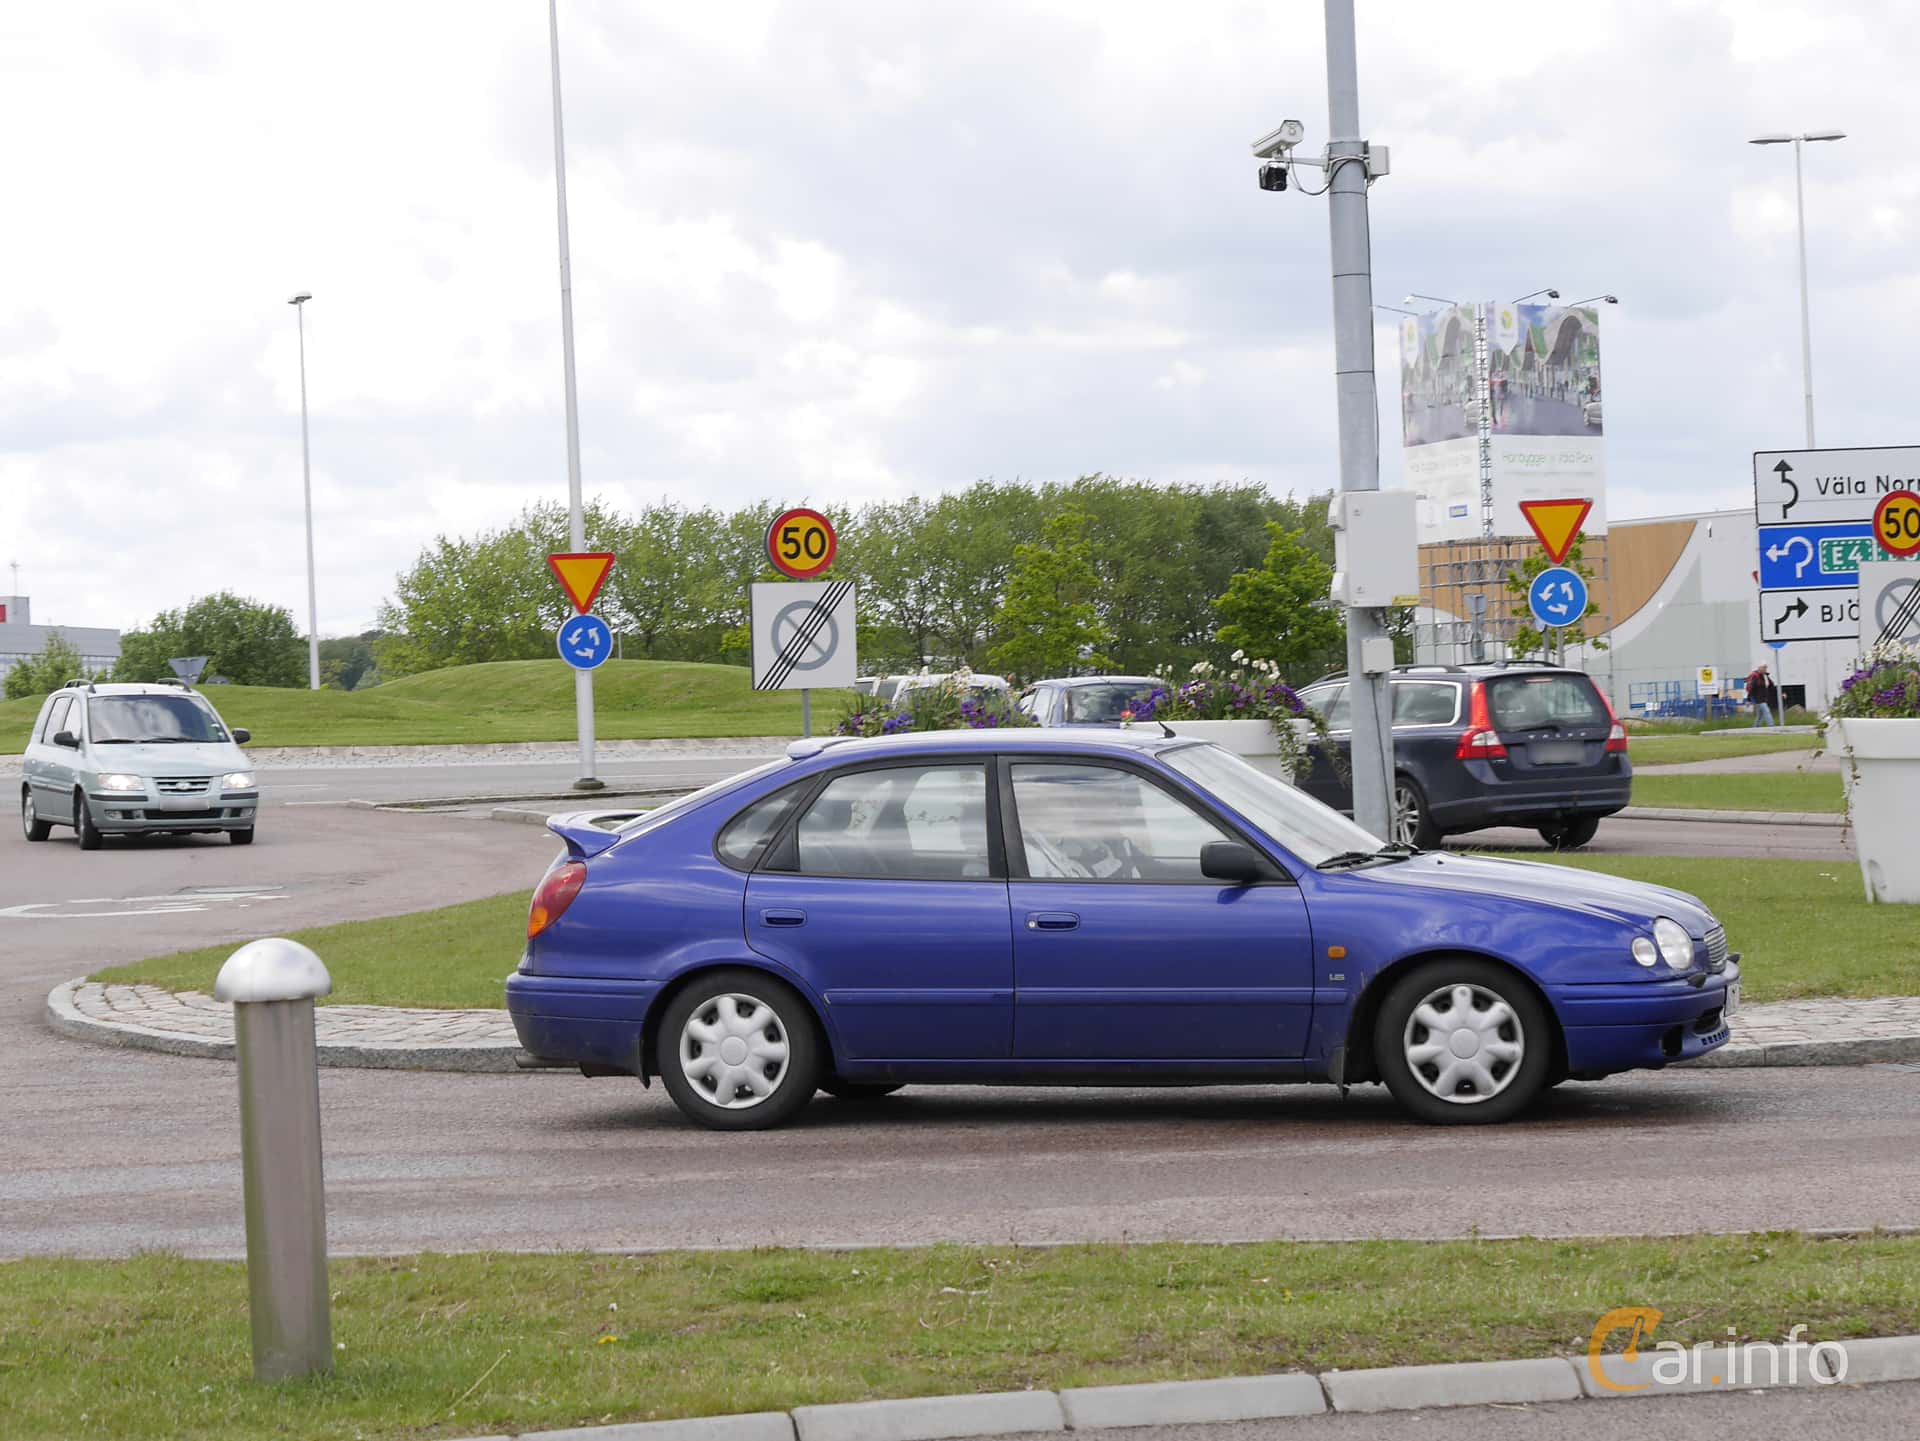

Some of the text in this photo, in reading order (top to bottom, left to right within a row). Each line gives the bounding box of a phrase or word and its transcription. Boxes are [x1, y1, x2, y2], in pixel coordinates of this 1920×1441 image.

[1816, 475, 1920, 495] Väla Nor
[1884, 507, 1920, 538] 50
[783, 527, 826, 559] 50
